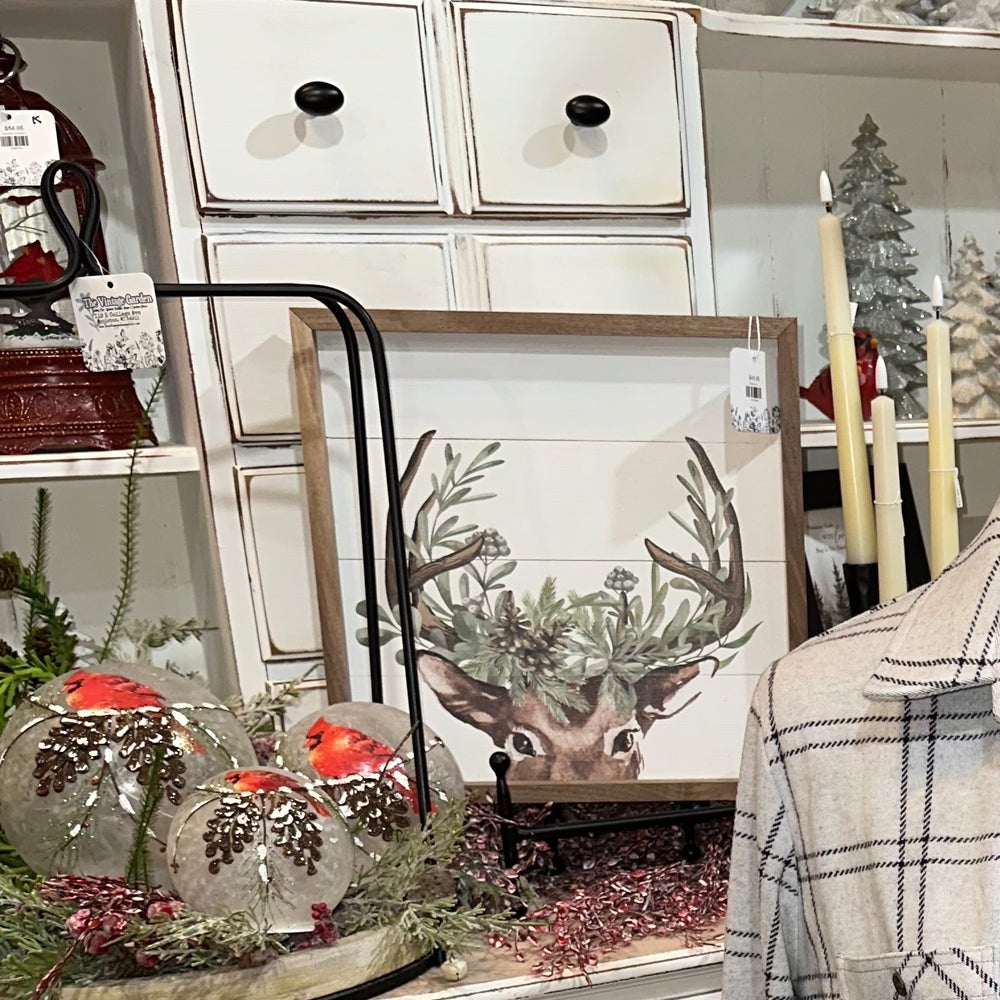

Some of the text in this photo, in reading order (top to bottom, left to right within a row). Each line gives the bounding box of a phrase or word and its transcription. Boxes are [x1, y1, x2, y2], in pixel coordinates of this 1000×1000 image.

[82, 296, 98, 309] The
[97, 296, 126, 308] Vintage
[125, 292, 154, 305] Garden
